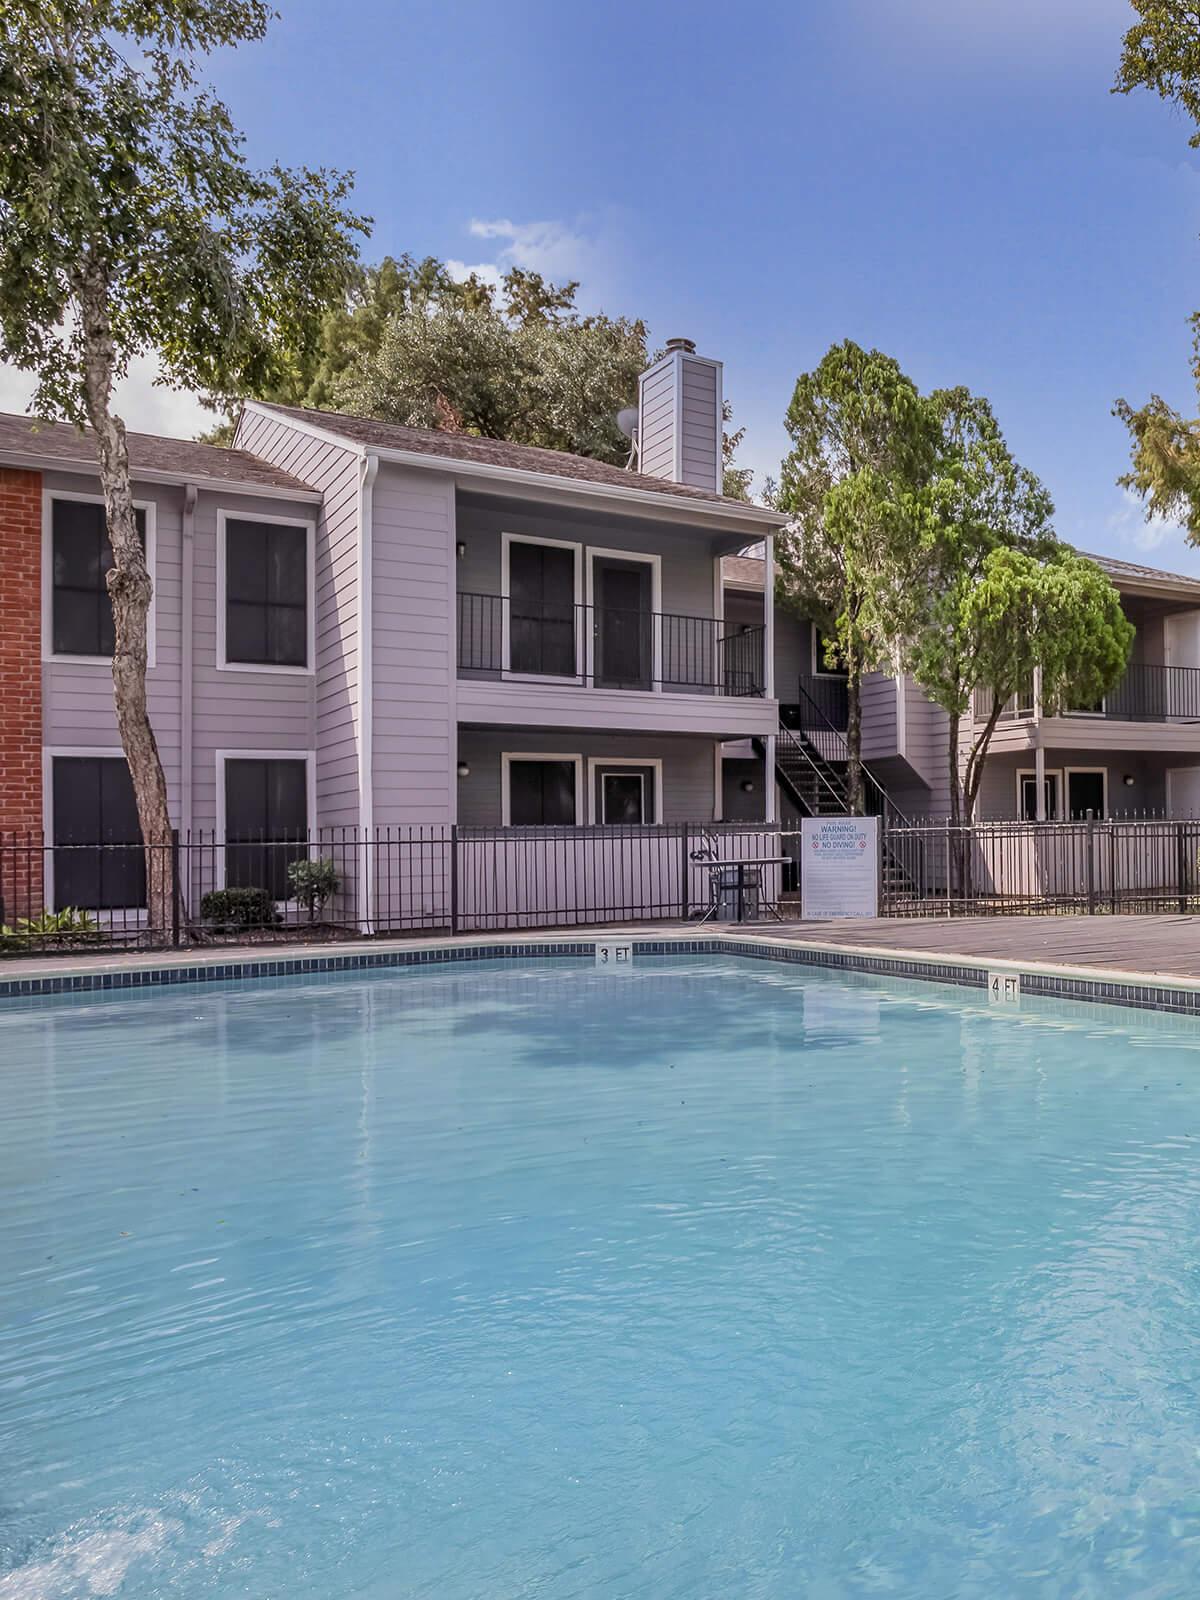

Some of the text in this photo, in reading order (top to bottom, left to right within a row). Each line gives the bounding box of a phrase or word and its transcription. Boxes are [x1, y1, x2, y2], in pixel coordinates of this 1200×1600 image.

[821, 825, 857, 833] WARNING!
[812, 833, 867, 841] NO LIFE GUARD ON DUTY
[822, 841, 856, 849] NO DIVING!
[992, 977, 1017, 992] 4 FT
